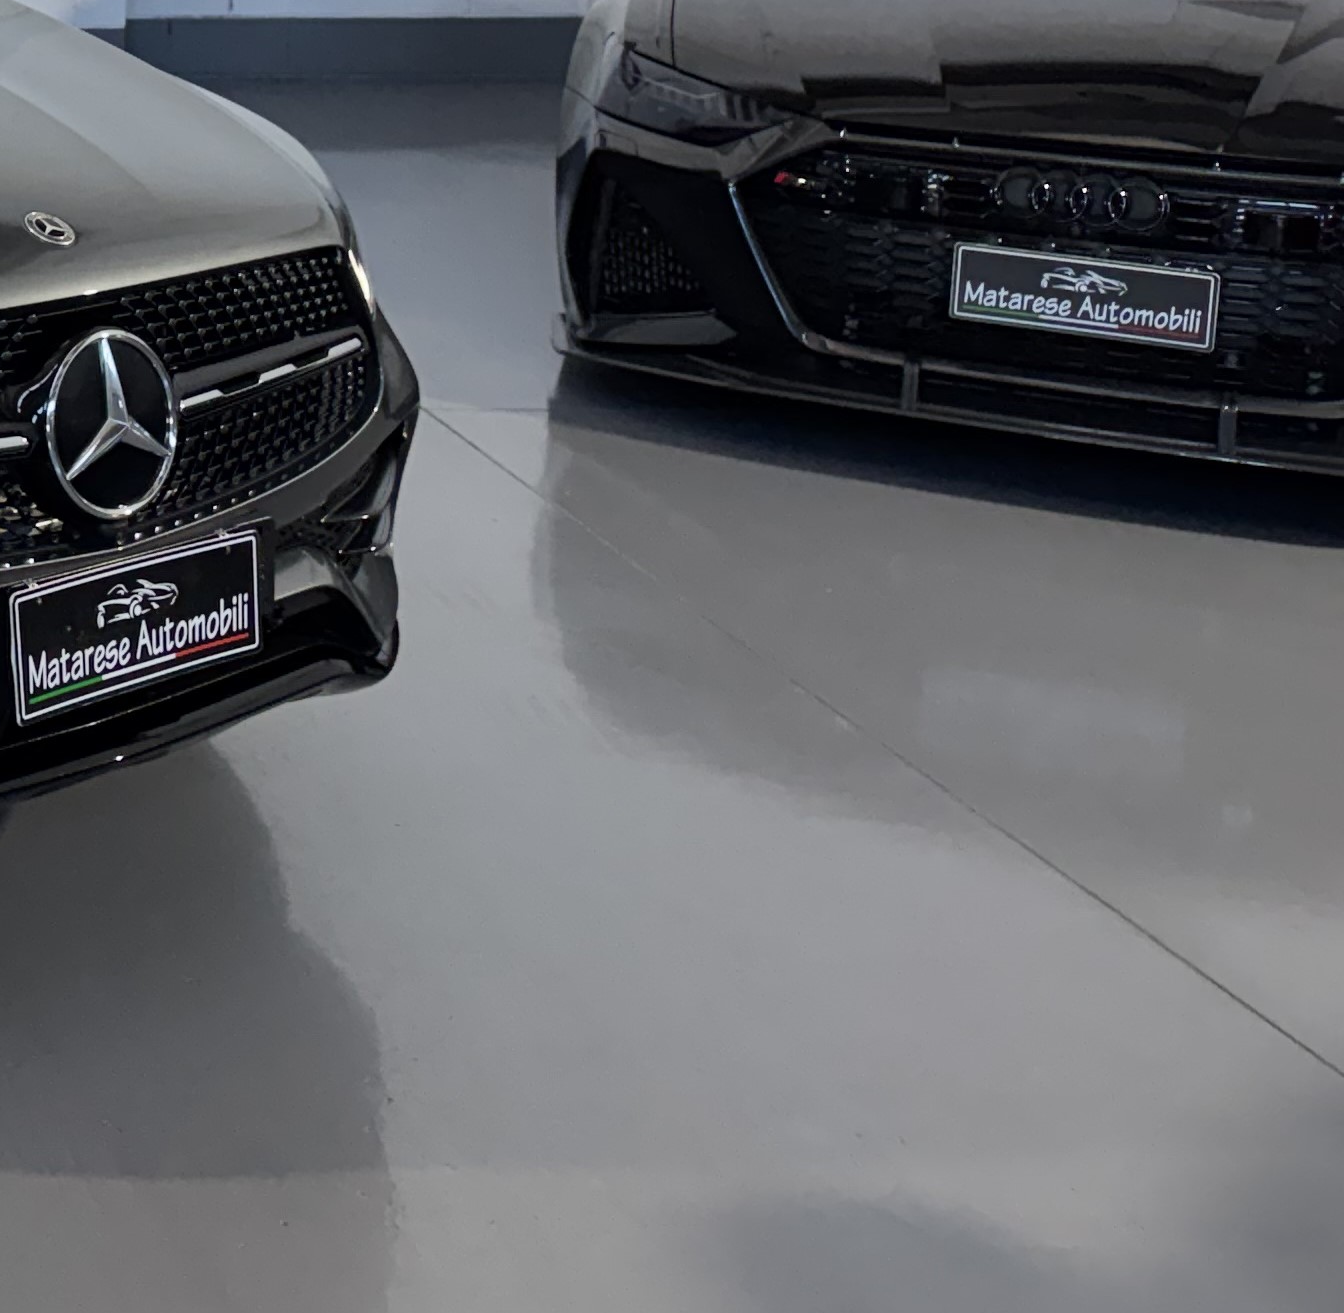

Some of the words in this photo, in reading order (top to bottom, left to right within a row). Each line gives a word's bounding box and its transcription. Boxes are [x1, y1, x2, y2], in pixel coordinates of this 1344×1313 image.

[963, 280, 1072, 318] Matarese
[1076, 295, 1203, 334] Automobili
[28, 636, 132, 695] Matarese
[136, 592, 250, 660] Automobili
